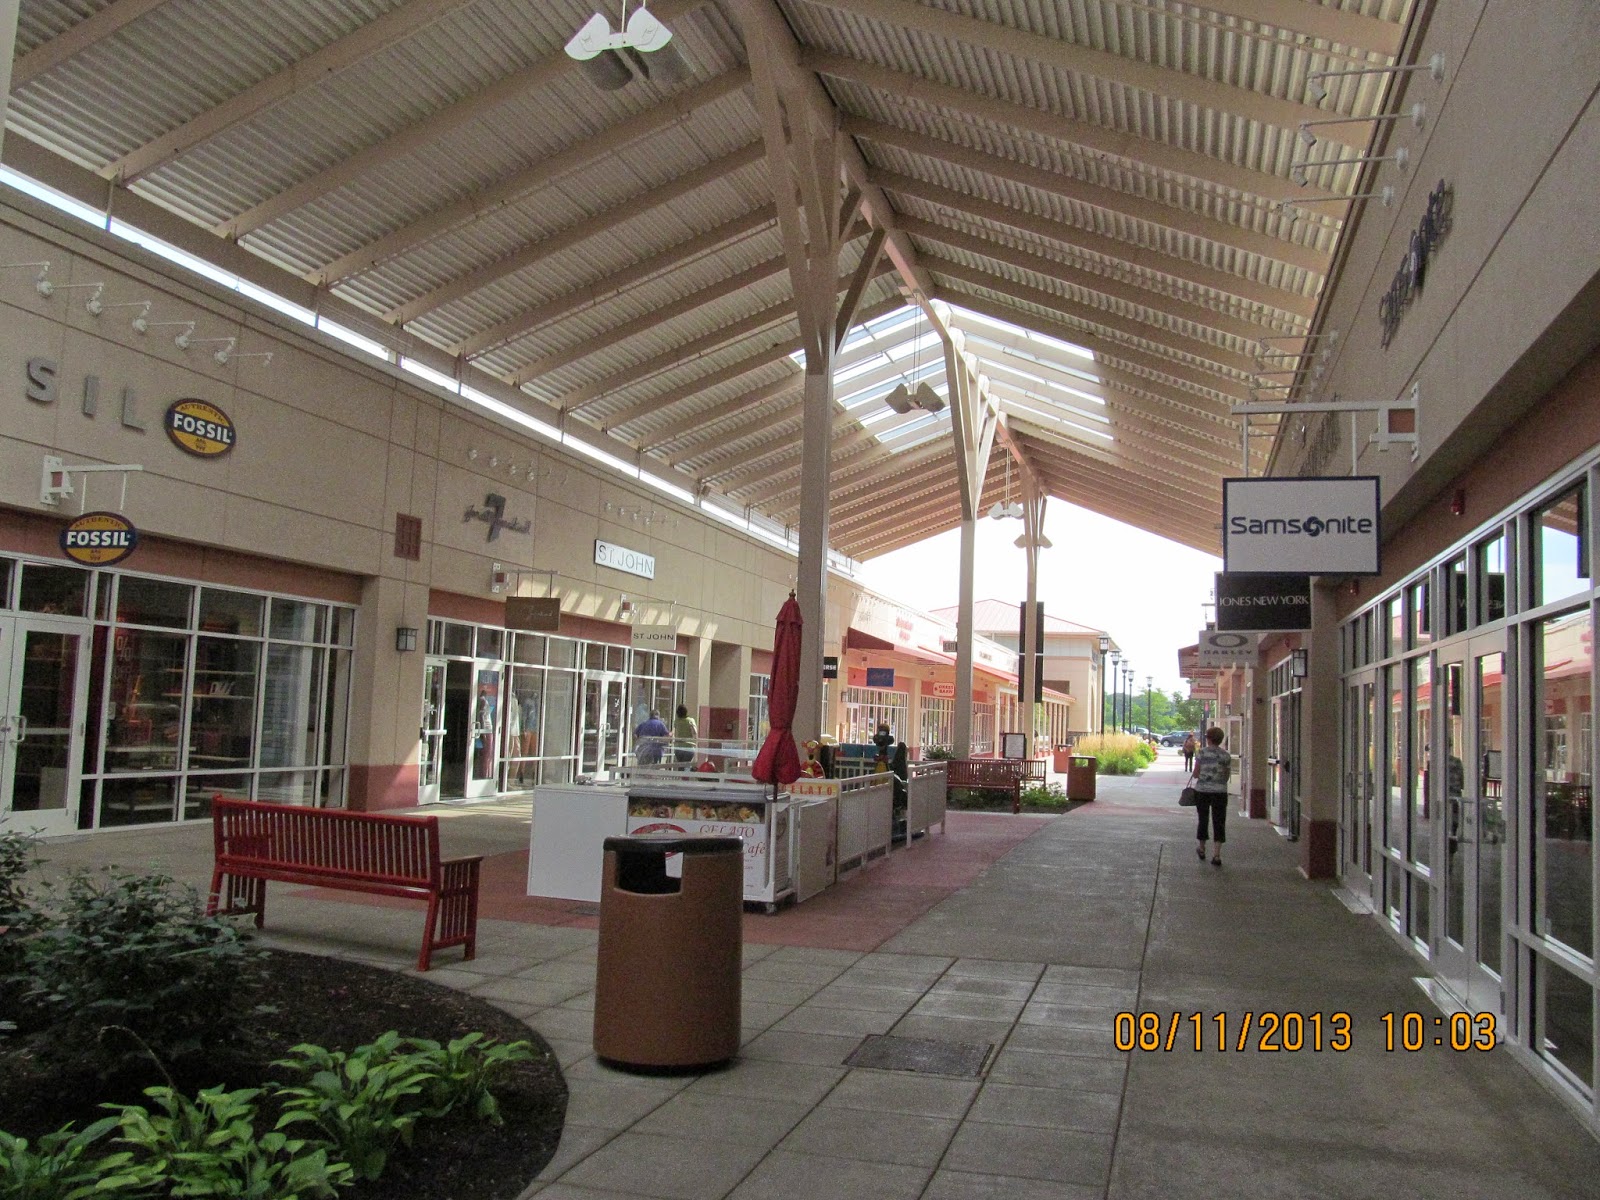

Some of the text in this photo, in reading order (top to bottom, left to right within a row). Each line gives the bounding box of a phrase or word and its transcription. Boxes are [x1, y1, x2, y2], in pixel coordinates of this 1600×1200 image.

[173, 412, 232, 443] FOSSIL
[1230, 515, 1373, 537] Samsonite
[66, 531, 130, 546] FOSSIL
[617, 551, 653, 576] JOHN
[1219, 594, 1309, 607] JONES NEW YORK
[647, 633, 674, 641] JOHN
[781, 784, 833, 796] GELATO
